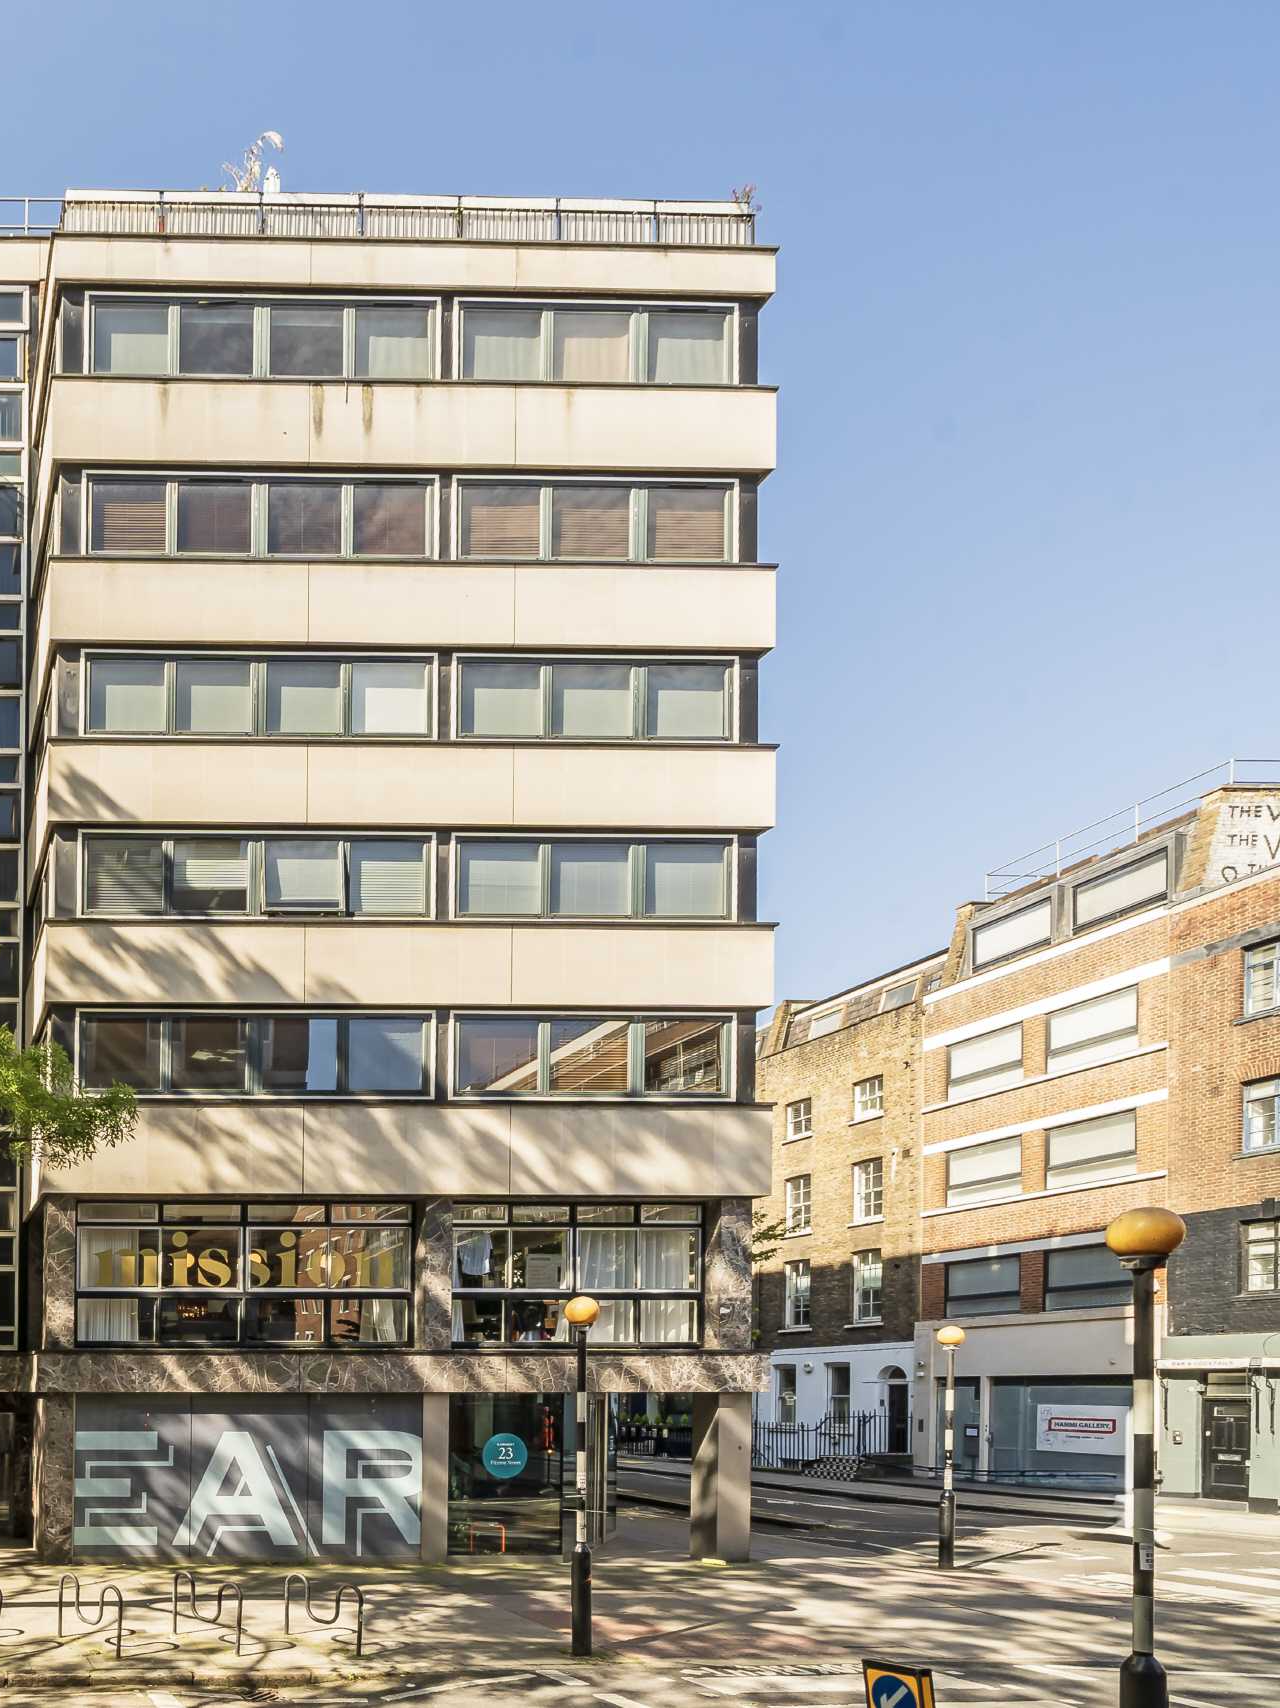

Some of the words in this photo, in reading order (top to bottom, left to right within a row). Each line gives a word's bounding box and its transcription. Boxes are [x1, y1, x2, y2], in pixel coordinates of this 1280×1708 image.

[1229, 805, 1262, 818] THE
[1226, 834, 1258, 847] THE
[94, 1231, 394, 1287] mission
[498, 1447, 514, 1460] 23
